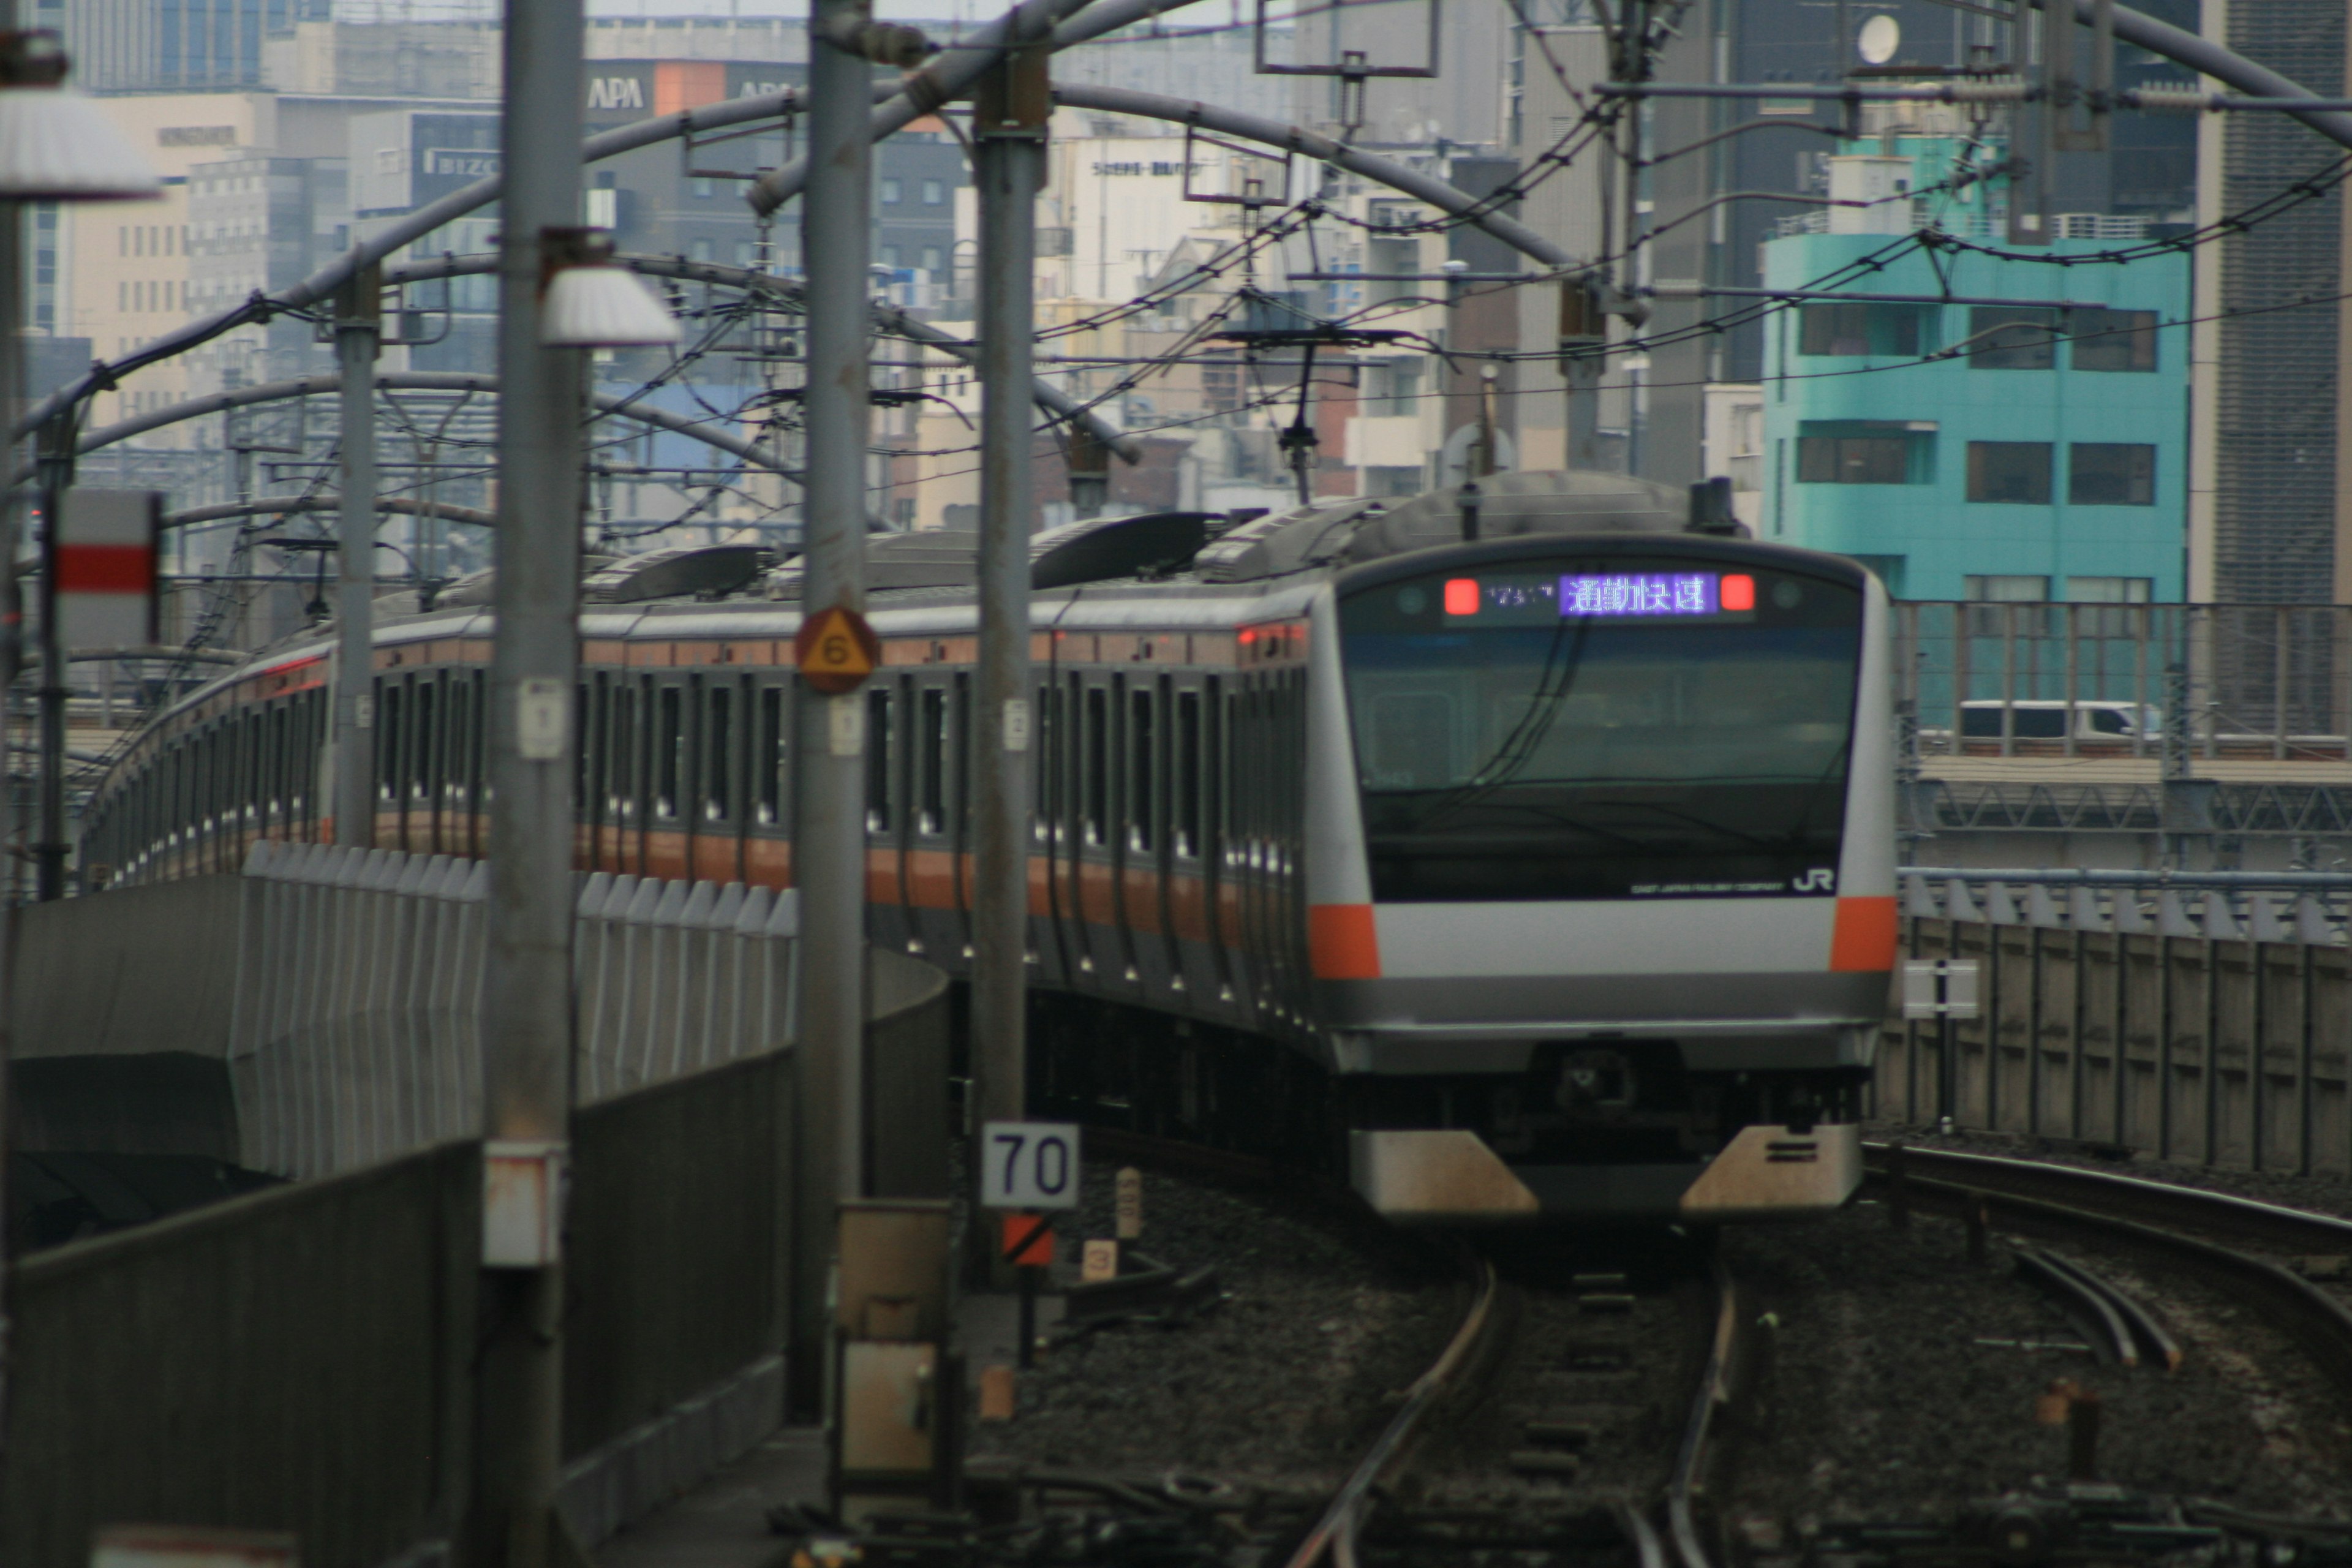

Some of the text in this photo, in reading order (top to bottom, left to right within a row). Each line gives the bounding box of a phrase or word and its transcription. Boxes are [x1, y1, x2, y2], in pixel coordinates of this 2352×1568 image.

[587, 78, 644, 108] APA
[1569, 577, 1706, 612] 通勤快速
[823, 635, 849, 665] 6
[1792, 868, 1834, 892] JR
[993, 1135, 1067, 1196] 70
